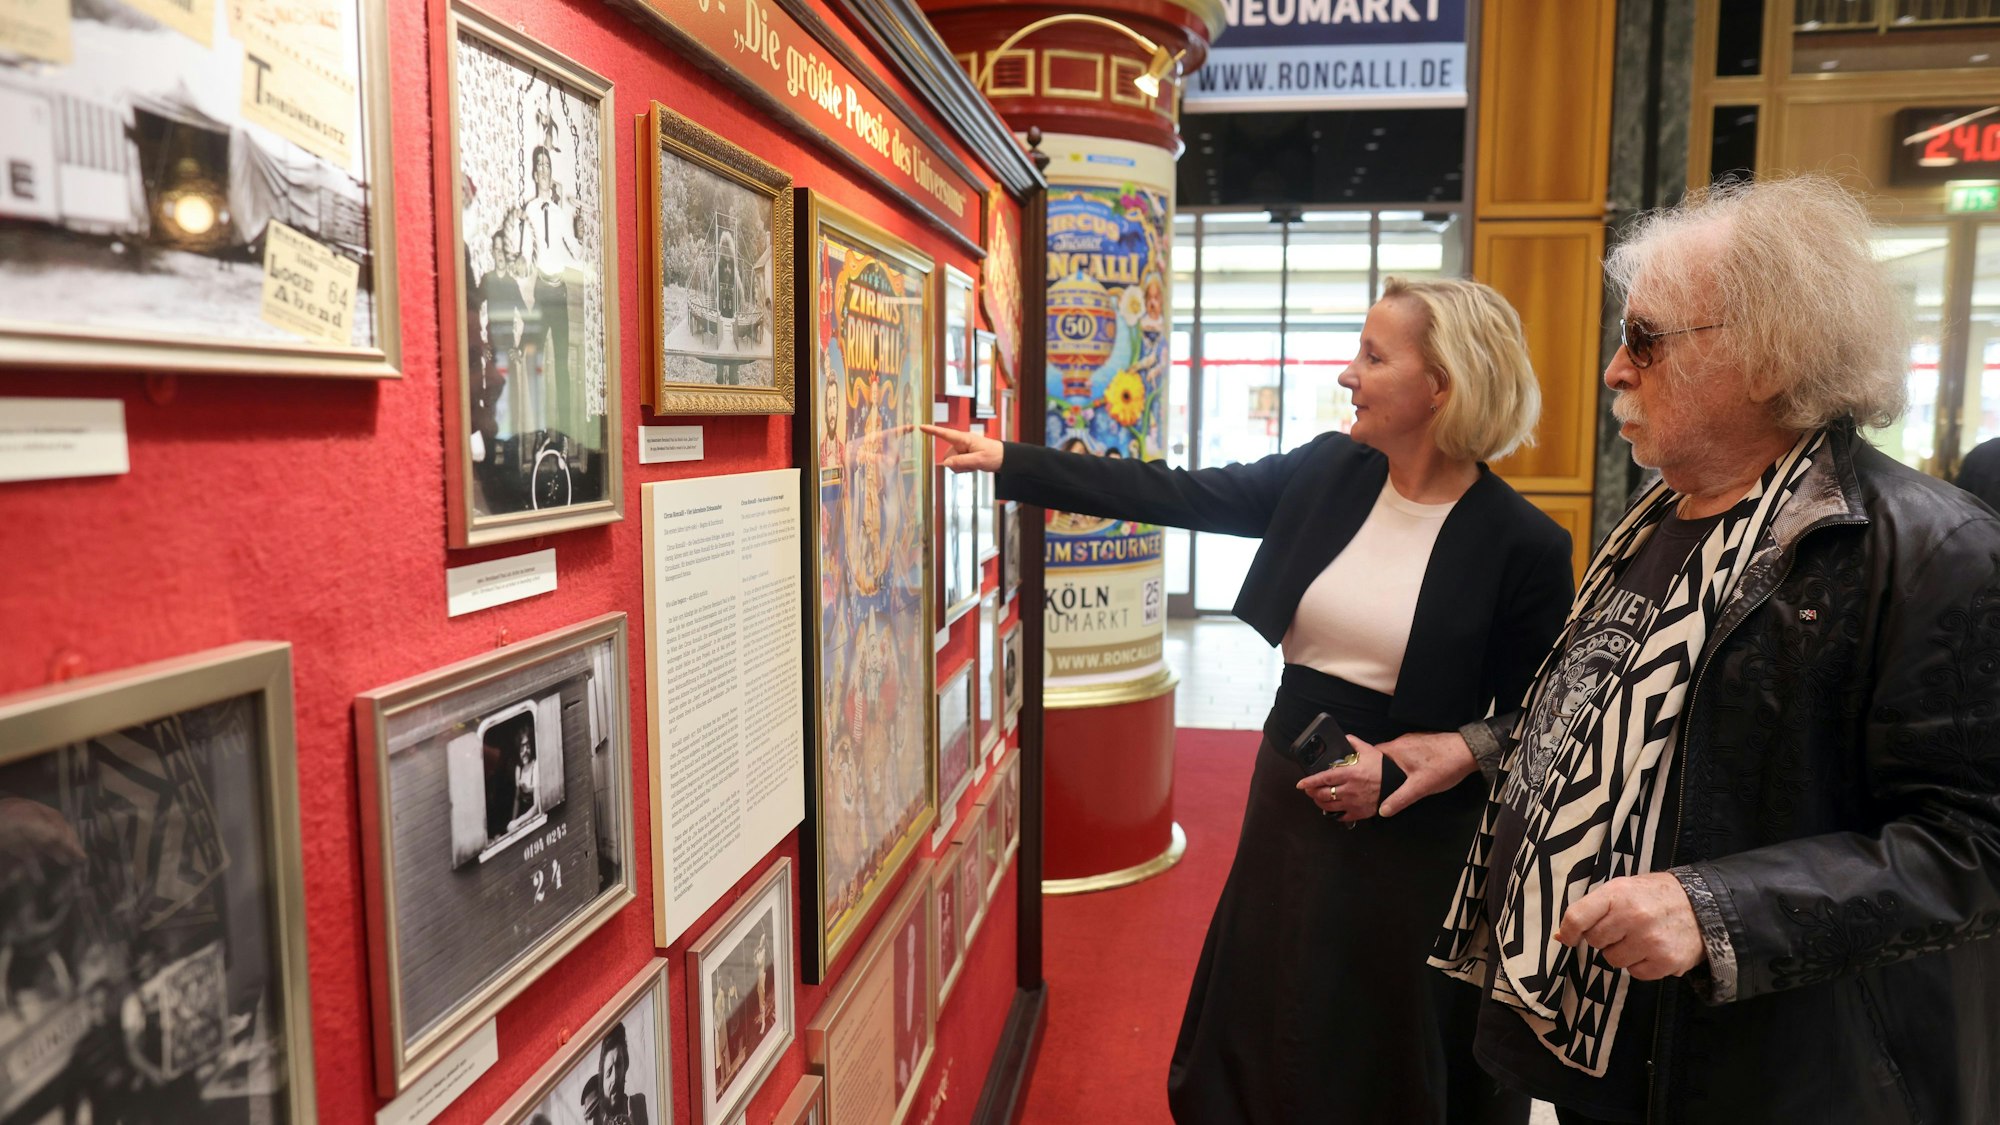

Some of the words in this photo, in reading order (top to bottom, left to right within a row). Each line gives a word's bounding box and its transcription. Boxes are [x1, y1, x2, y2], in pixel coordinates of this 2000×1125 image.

[734, 0, 780, 70] „Die
[786, 45, 842, 119] größte
[845, 83, 890, 158] Poesie
[891, 128, 911, 176] des
[1199, 58, 1454, 92] WWW.RONCALLI.DE
[273, 285, 343, 329] Abend
[850, 283, 901, 325] ZIRKUS
[847, 314, 901, 375] RONCALLI
[1064, 316, 1091, 337] 50
[1045, 583, 1110, 616] KÖLN
[1145, 580, 1159, 606] 25
